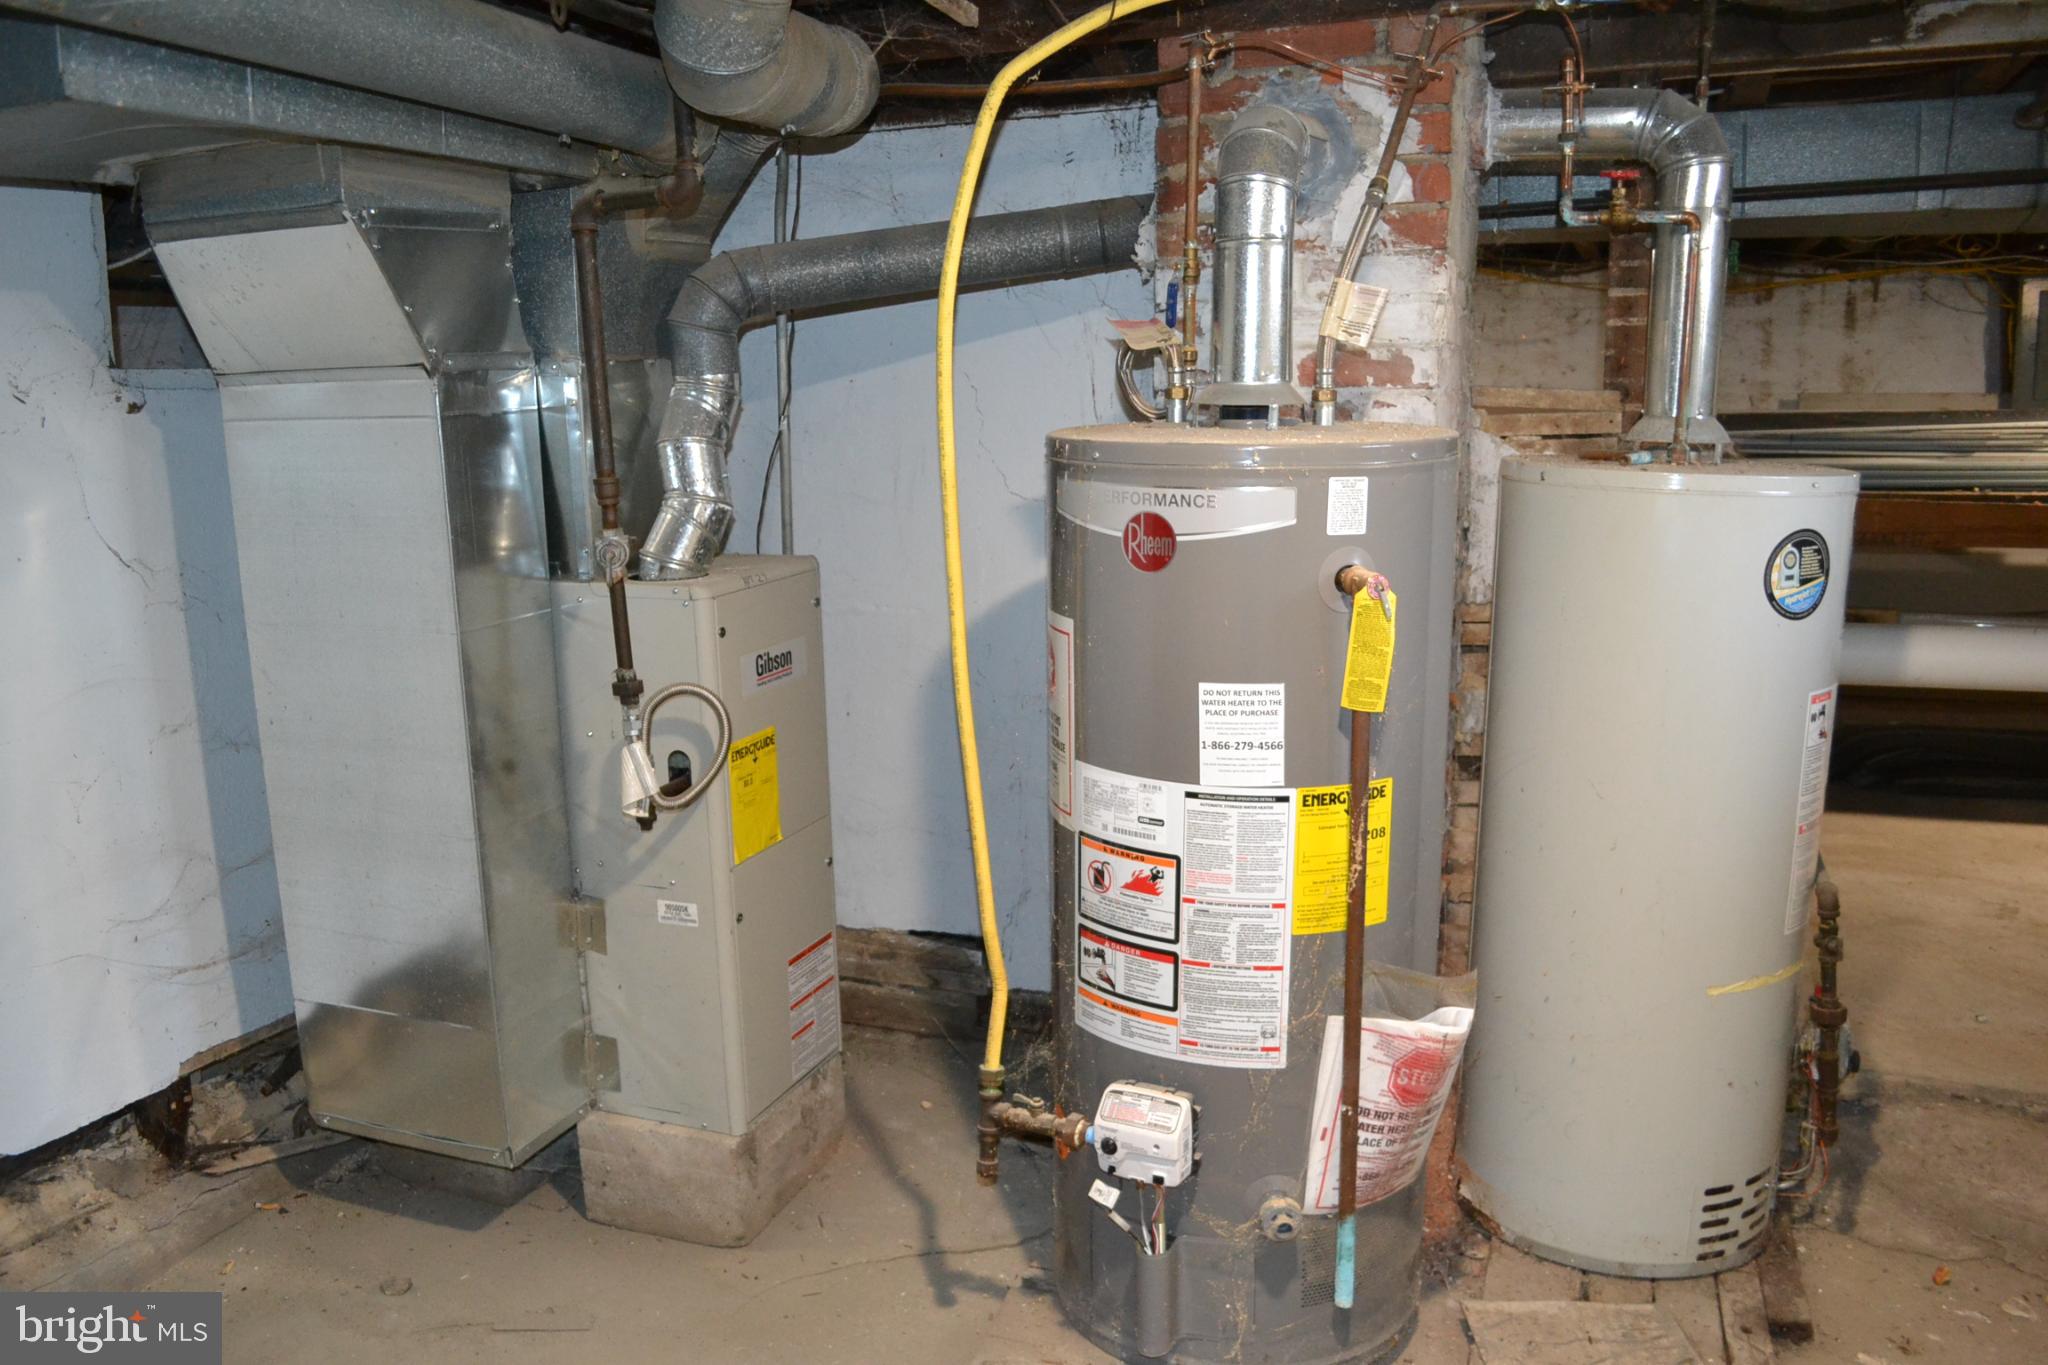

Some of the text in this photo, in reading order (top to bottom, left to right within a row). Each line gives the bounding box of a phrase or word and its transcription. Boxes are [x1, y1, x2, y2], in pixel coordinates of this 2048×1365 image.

[1103, 489, 1217, 509] ERFORMANCE
[1127, 513, 1173, 563] Rheem
[755, 650, 793, 677] Gibson
[1202, 689, 1281, 697] DO NOT RETURN THIS
[1201, 699, 1226, 707] WATER
[1269, 699, 1283, 707] THE
[1205, 709, 1279, 717] PLACE OF PURCHASE
[1201, 740, 1284, 751] 1-866-279-4566
[1110, 847, 1145, 862] WARNING
[1110, 942, 1141, 956] DANGER
[1111, 1002, 1141, 1018] WARNING
[1358, 1122, 1384, 1134] ATER
[1357, 1136, 1382, 1148] LACE
